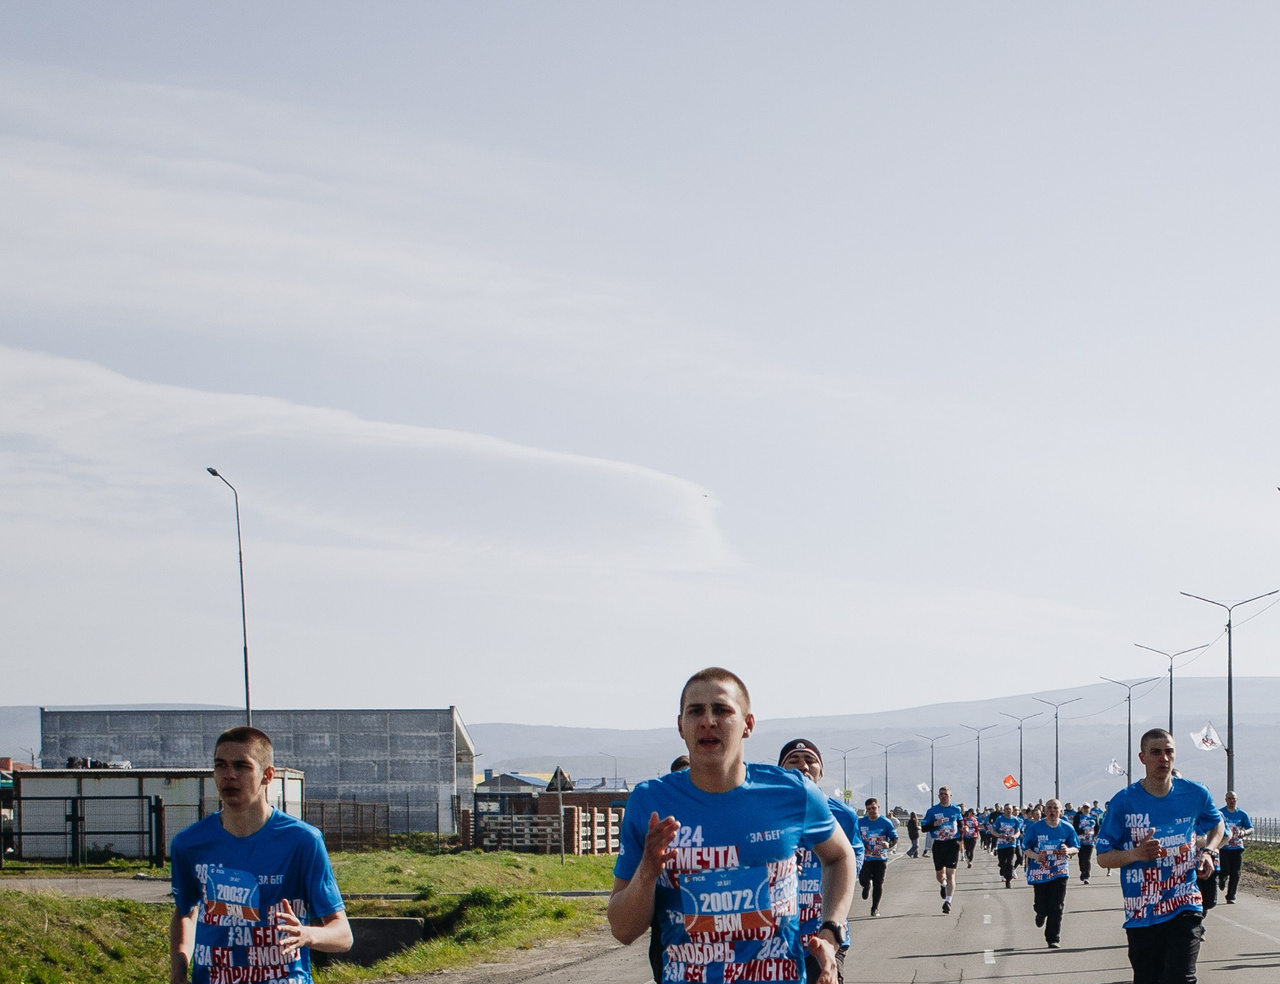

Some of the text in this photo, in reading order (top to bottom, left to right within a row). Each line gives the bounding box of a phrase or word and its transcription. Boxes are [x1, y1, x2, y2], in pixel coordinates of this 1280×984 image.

[1125, 813, 1151, 828] 2024
[665, 845, 740, 870] #МЕЧТА
[1126, 867, 1162, 883] #ЗАБЕГ
[216, 883, 251, 904] 20037
[700, 889, 755, 913] 20072
[194, 944, 234, 967] #ЗАБЕГ
